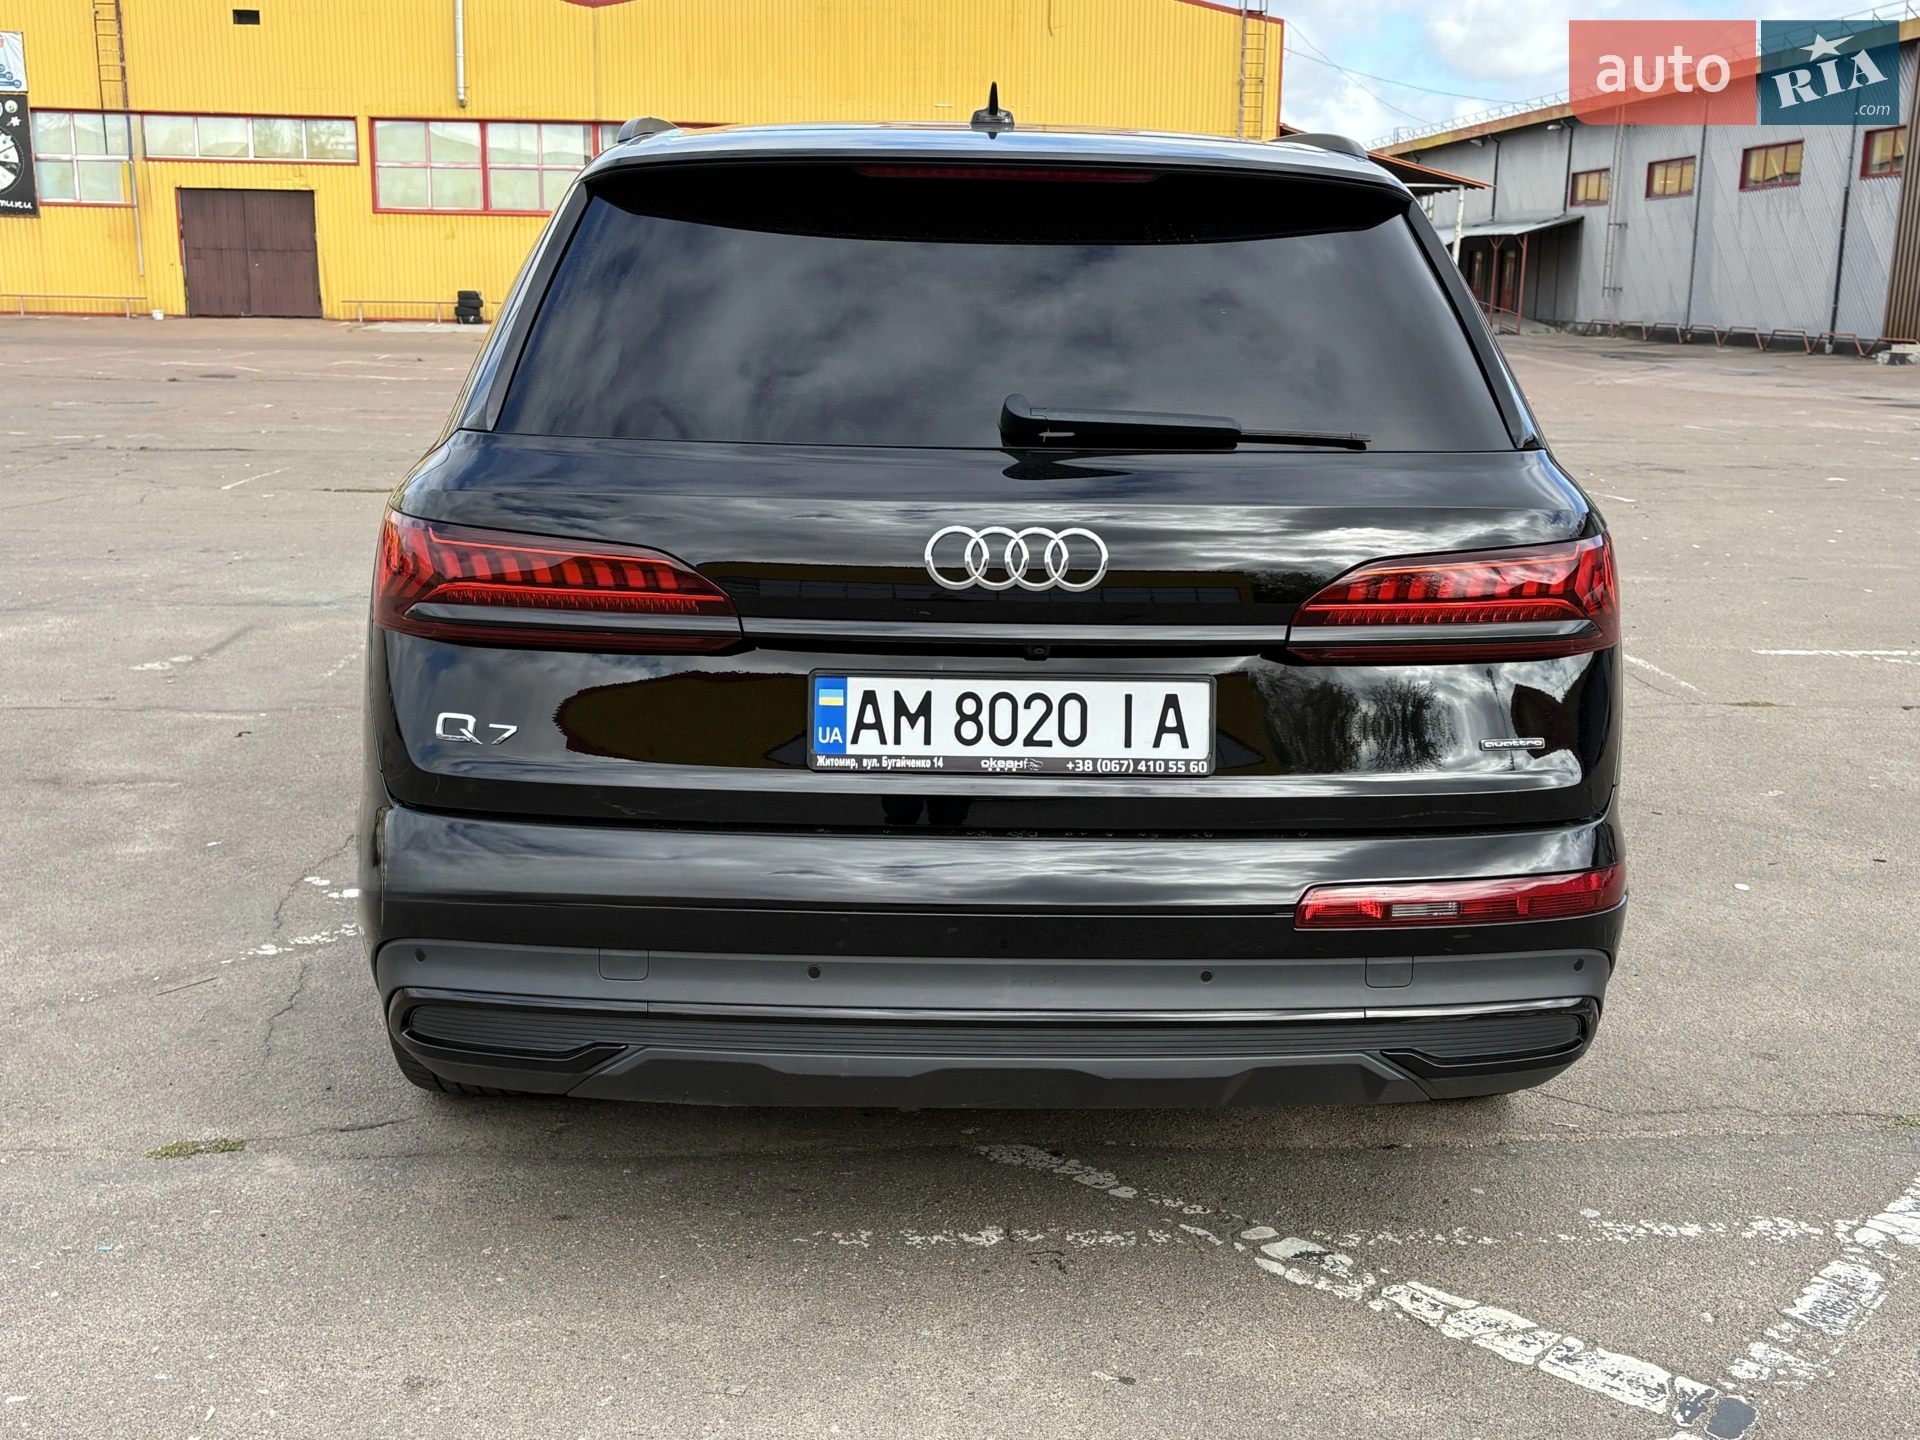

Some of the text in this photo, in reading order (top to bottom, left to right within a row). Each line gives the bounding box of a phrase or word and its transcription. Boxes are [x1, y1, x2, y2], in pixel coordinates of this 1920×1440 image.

[850, 689, 932, 746] AM
[954, 690, 1088, 748] 8020
[435, 711, 519, 746] Q7
[818, 726, 843, 744] UA
[1484, 740, 1543, 748] quattro
[816, 755, 859, 770] Житомир,
[862, 757, 880, 770] вул.
[933, 757, 944, 769] 14
[1066, 758, 1208, 774] +38 (067) 410 55 60
